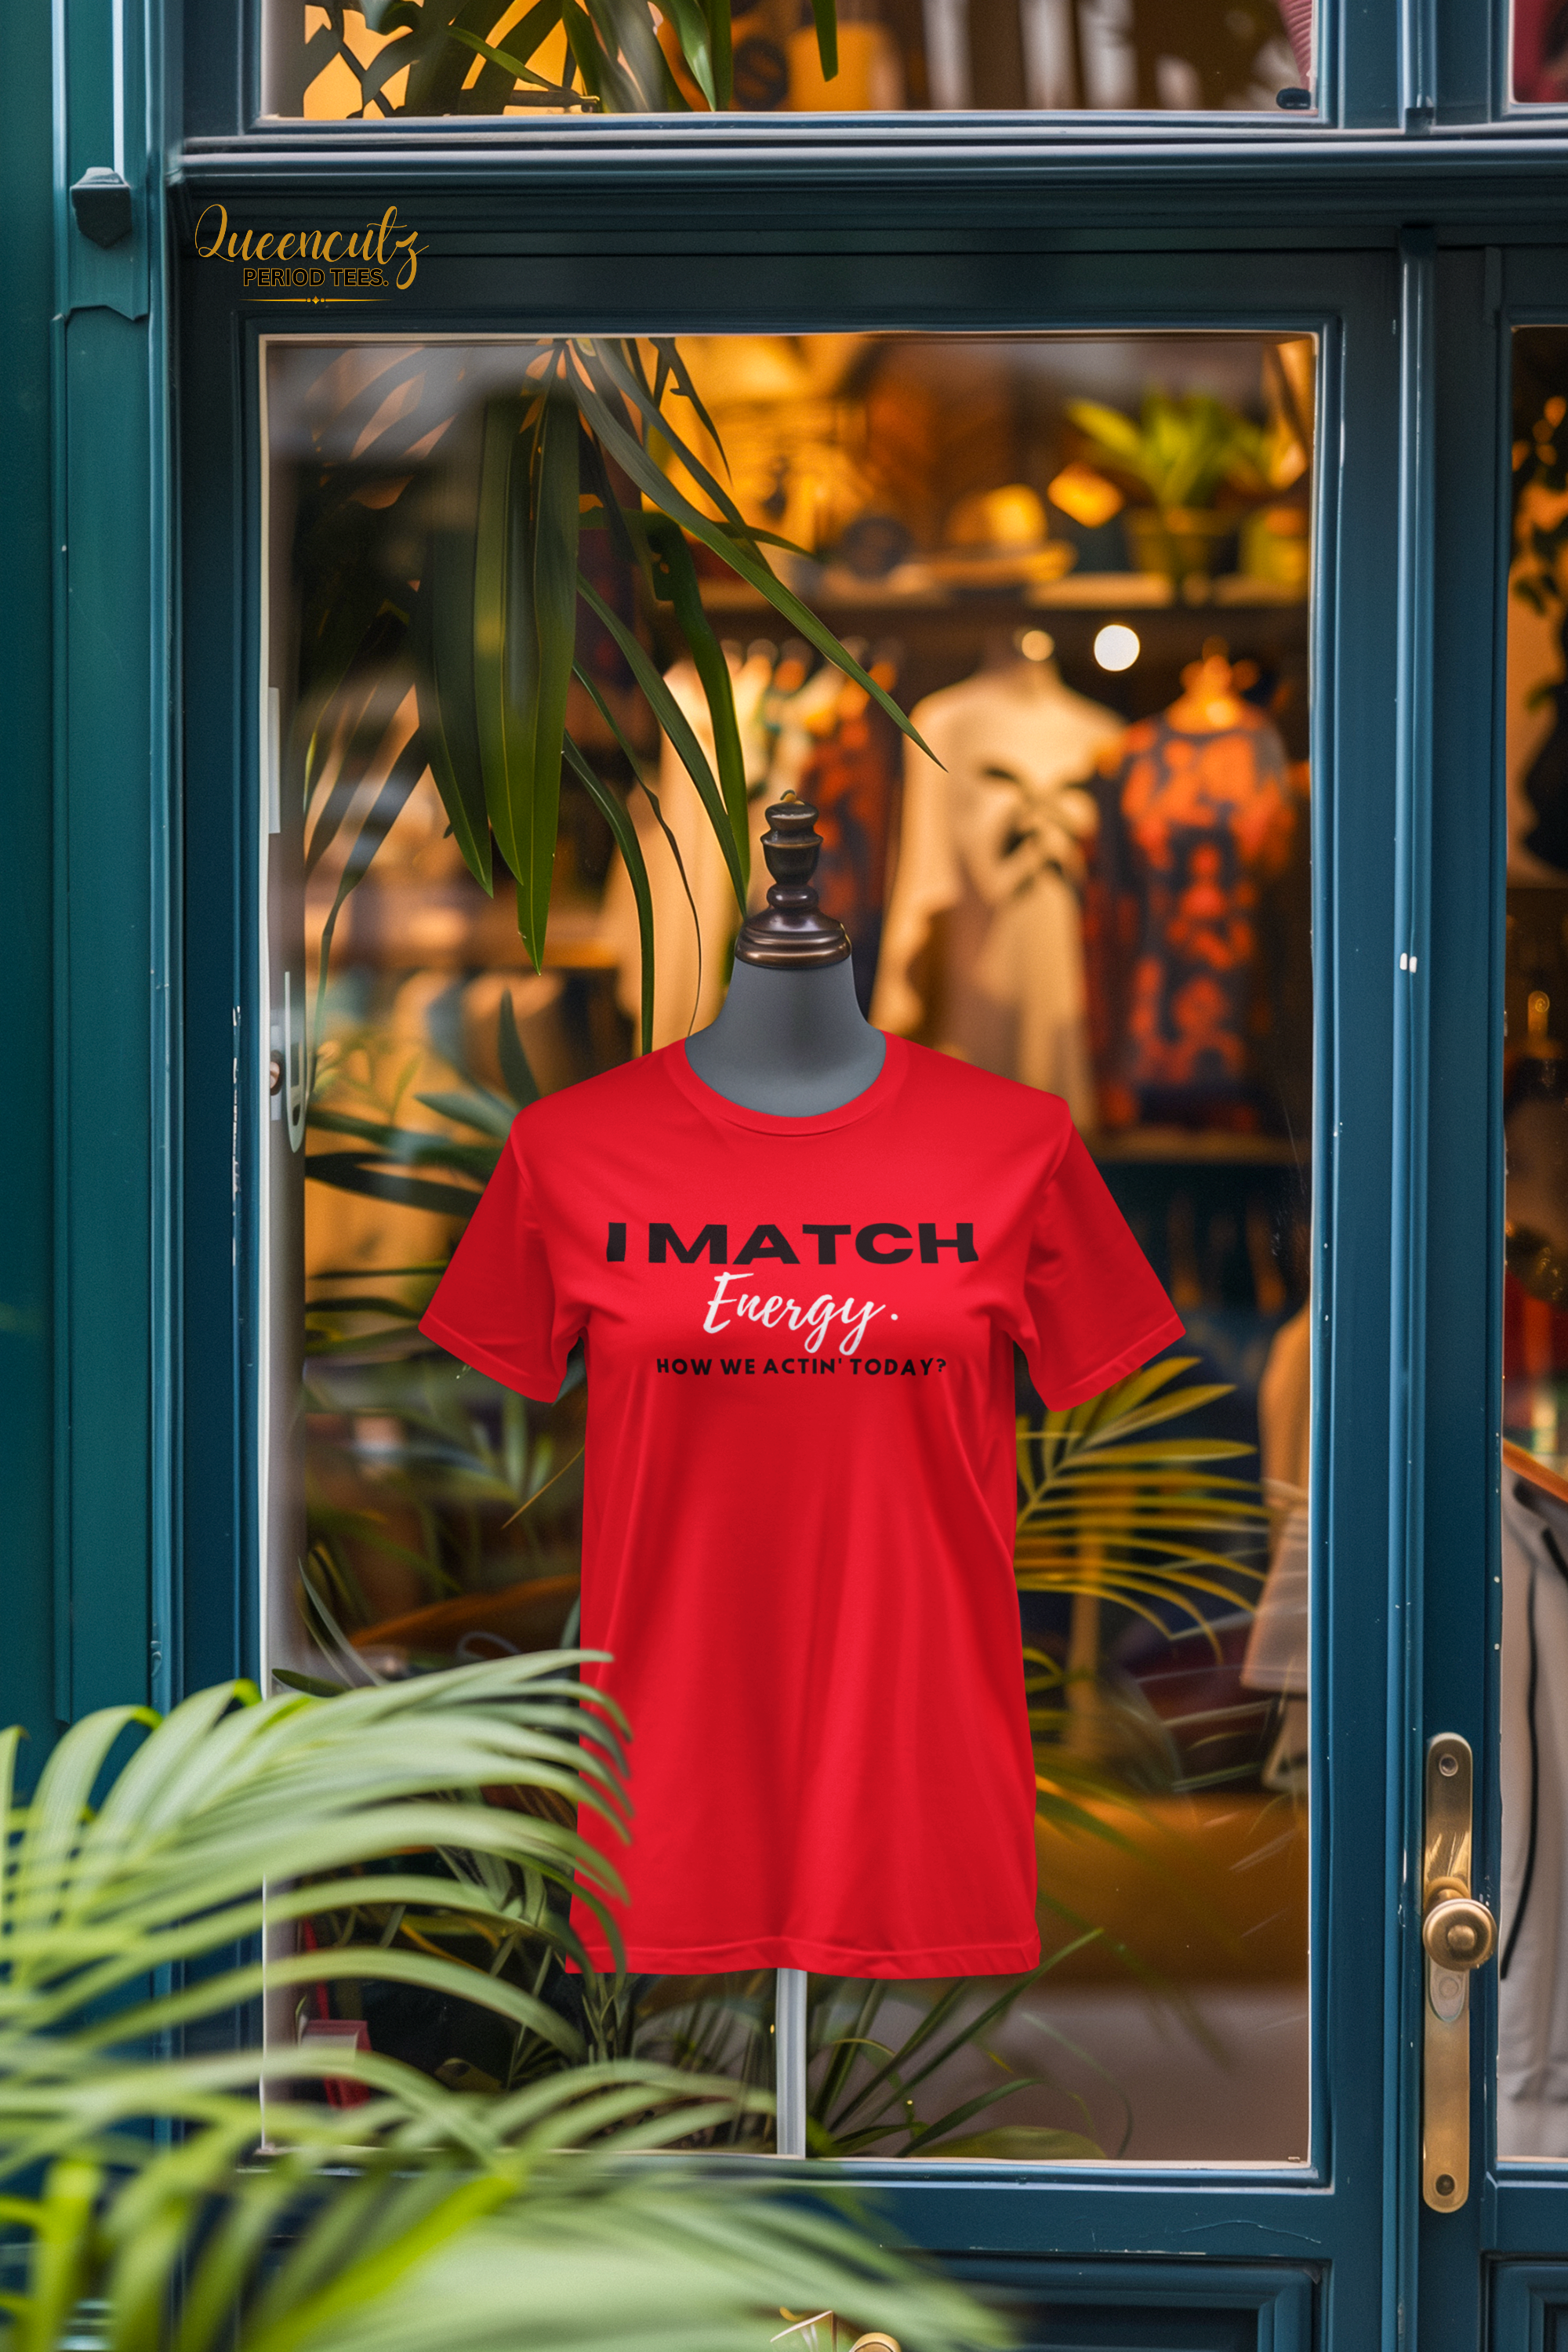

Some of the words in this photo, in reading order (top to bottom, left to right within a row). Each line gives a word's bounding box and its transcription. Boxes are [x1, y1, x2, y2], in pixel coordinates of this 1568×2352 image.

[606, 1221, 626, 1262] I
[648, 1221, 979, 1265] MATCH
[702, 1271, 899, 1356] Energy.
[656, 1357, 712, 1376] HOW
[720, 1358, 756, 1375] WE
[763, 1357, 843, 1375] ACTIN'
[851, 1357, 947, 1377] TODAY?
